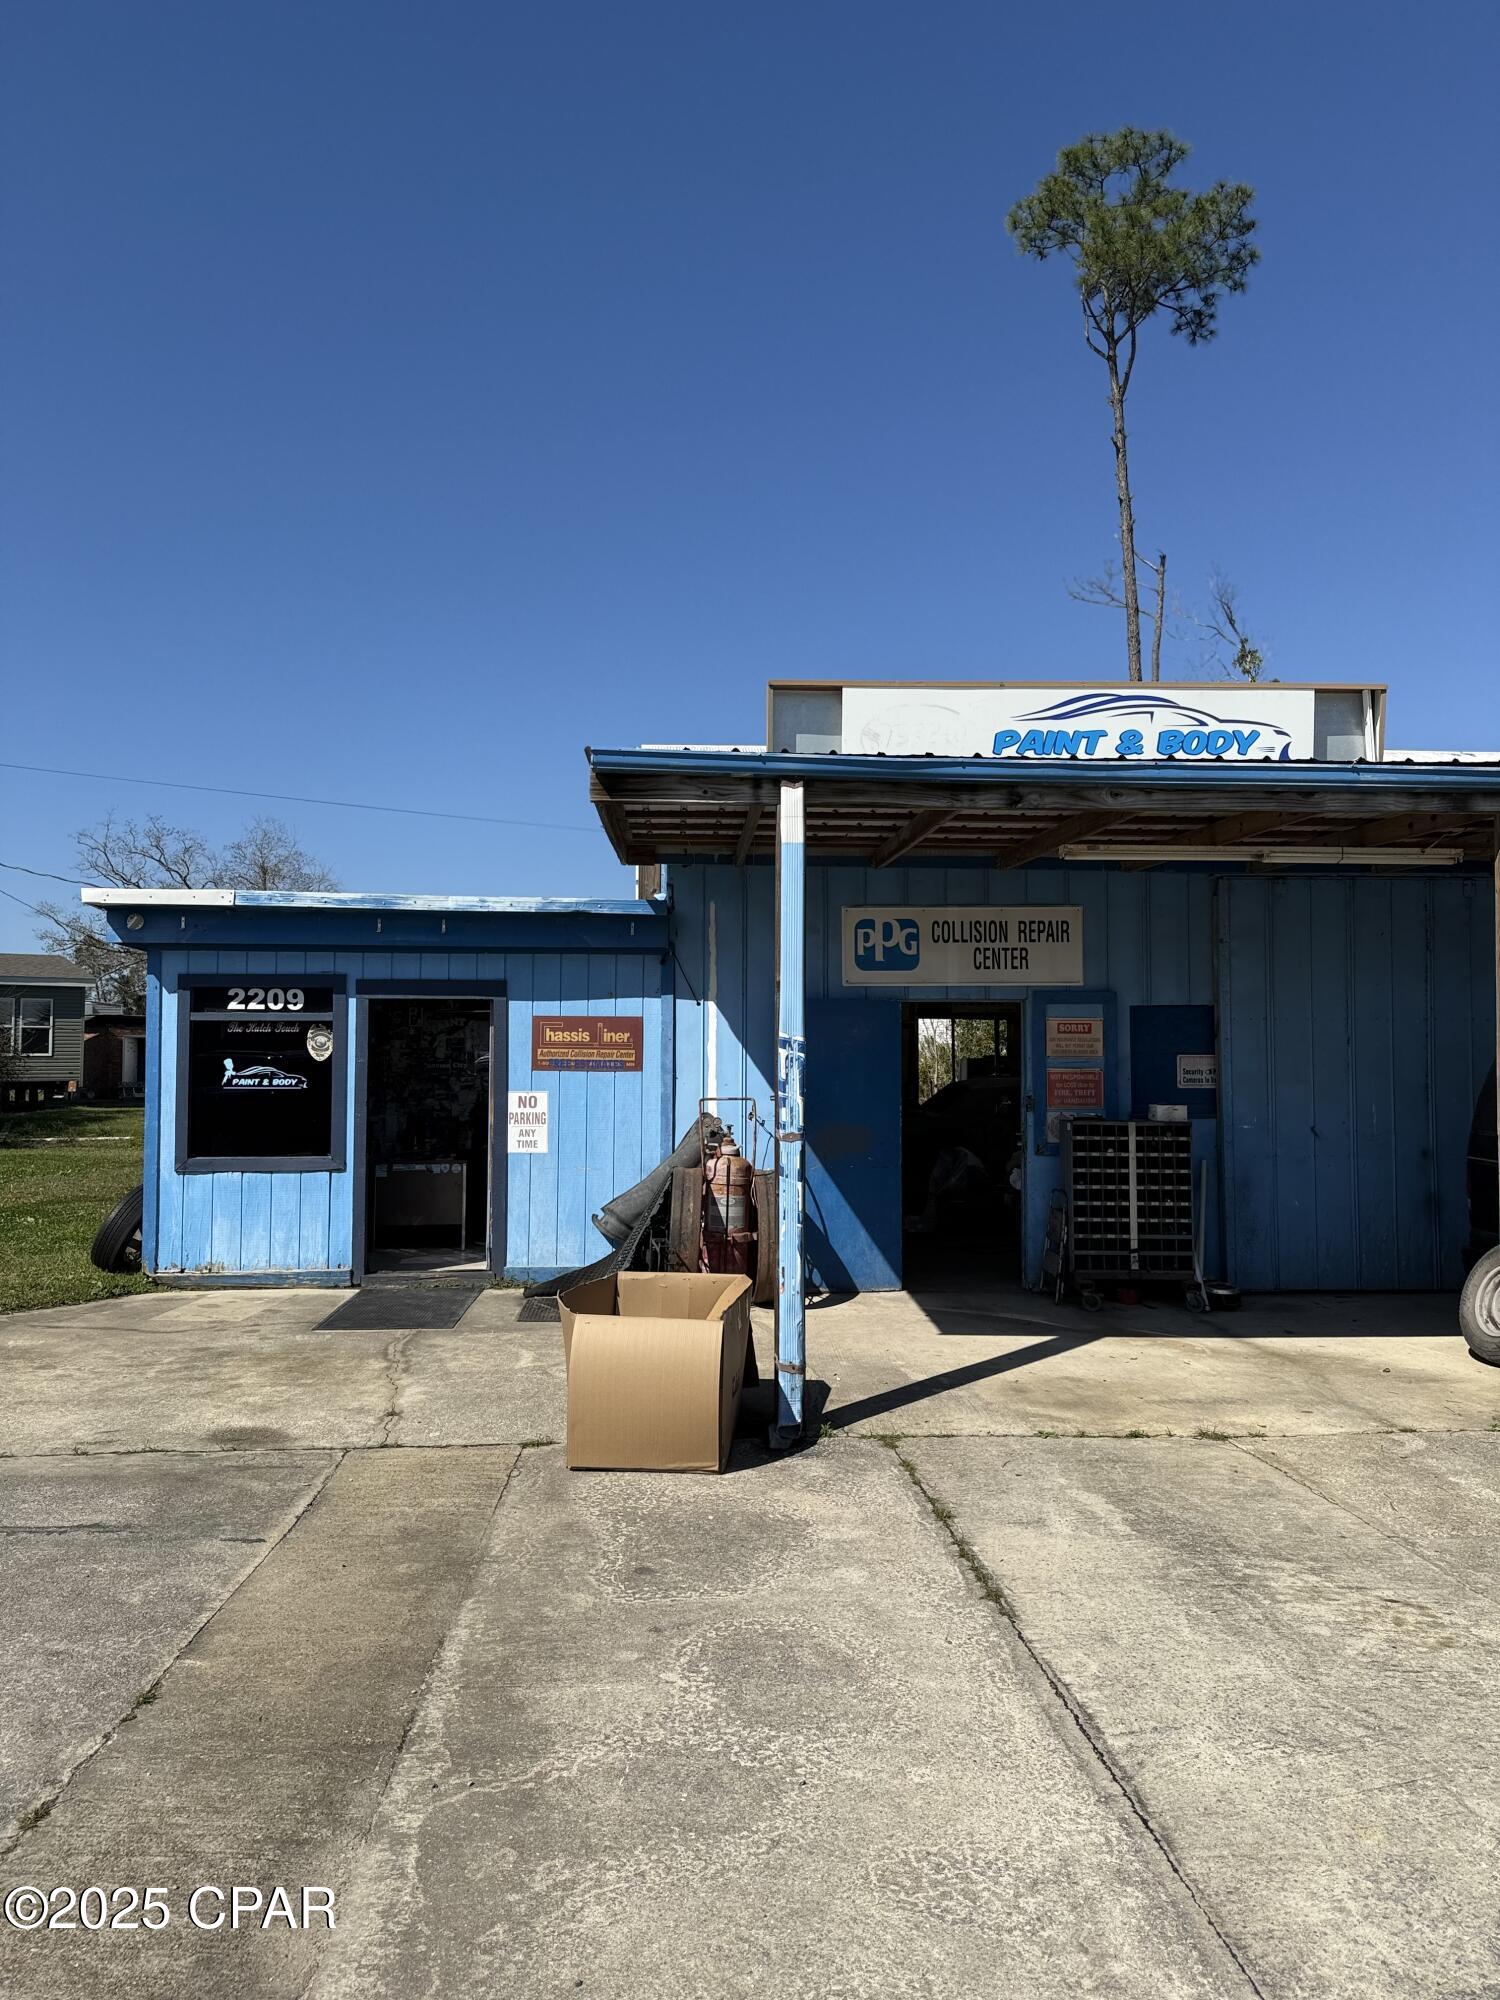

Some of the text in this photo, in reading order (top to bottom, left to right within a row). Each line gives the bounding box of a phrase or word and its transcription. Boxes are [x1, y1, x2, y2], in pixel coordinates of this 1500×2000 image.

[993, 729, 1108, 757] PAINT
[1115, 729, 1145, 756] &
[1156, 729, 1262, 757] BODY
[857, 918, 1071, 961] PPG COLLISION REPAIR
[973, 947, 1029, 970] CENTER
[226, 988, 305, 1011] 2209
[227, 1021, 244, 1033] The
[1058, 1024, 1090, 1032] SORRY
[539, 1049, 635, 1060] Authorized Collision Repair Center
[1183, 1068, 1203, 1076] Security
[231, 1078, 298, 1086] PAINT & BODY
[518, 1095, 538, 1109] NO
[508, 1112, 547, 1125] PARKING
[518, 1129, 537, 1138] ANY
[517, 1140, 539, 1149] TIME
